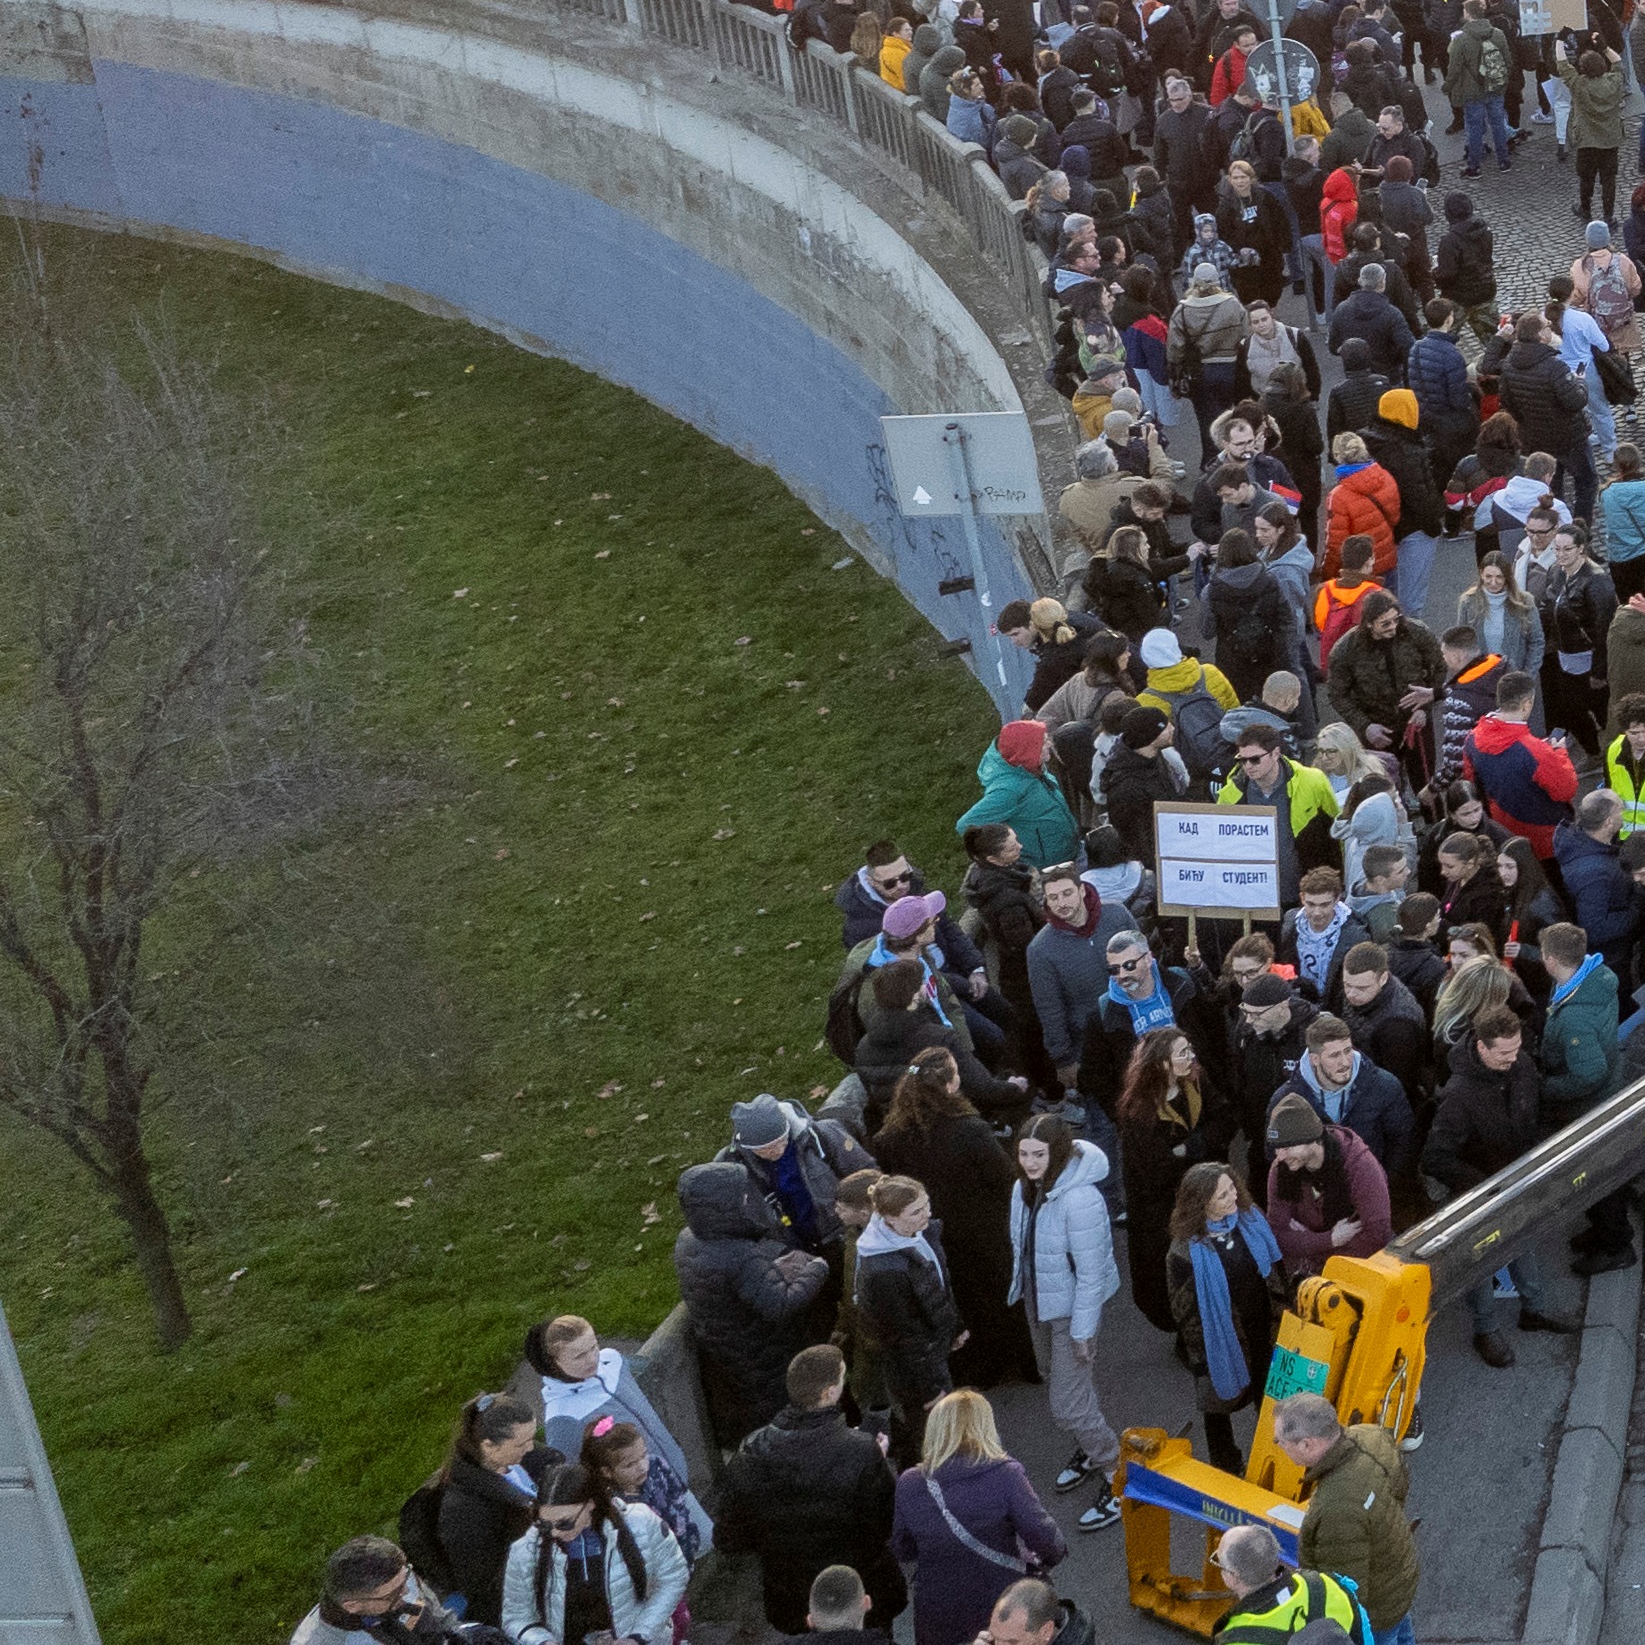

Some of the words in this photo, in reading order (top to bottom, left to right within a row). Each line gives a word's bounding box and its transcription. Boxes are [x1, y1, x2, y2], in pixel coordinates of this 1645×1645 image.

[1179, 822, 1199, 835] КАД
[1219, 824, 1268, 836] ПОРАСТЕМ
[1179, 869, 1204, 882] БИЋУ
[1222, 872, 1268, 885] СТУДЕНТ!
[1280, 1354, 1296, 1377] NS
